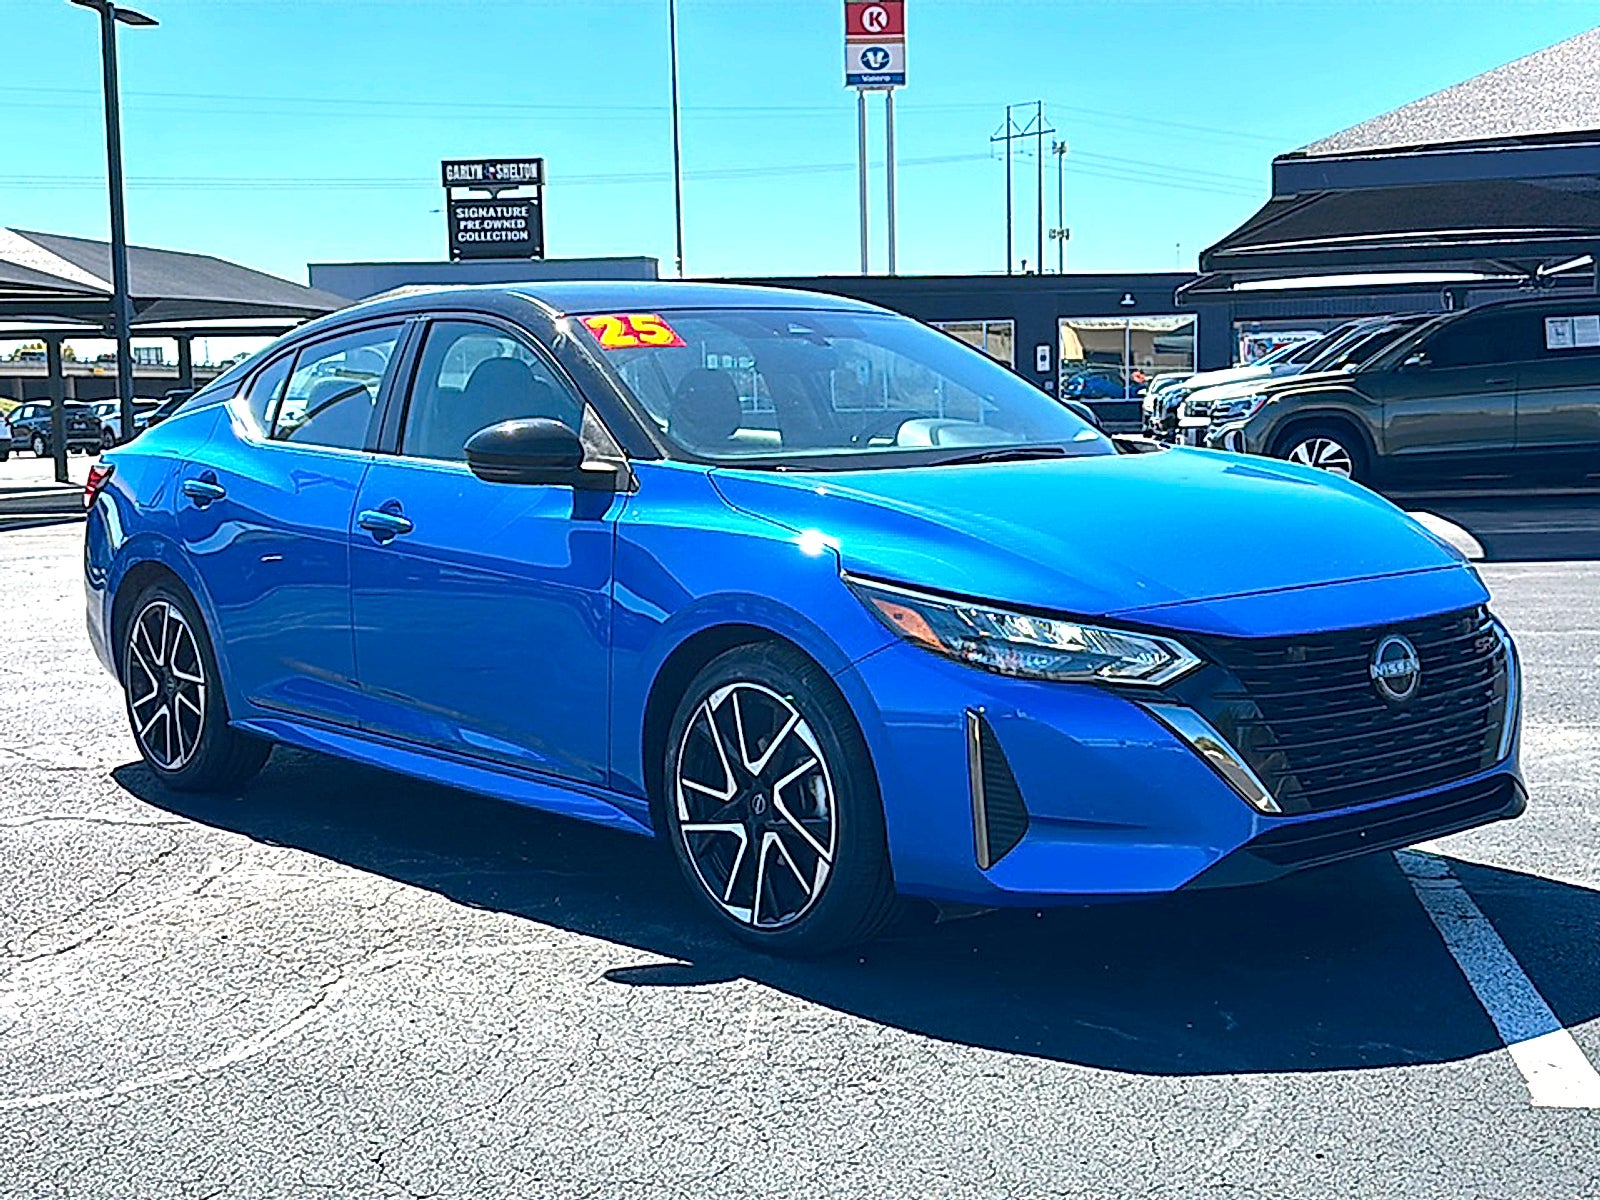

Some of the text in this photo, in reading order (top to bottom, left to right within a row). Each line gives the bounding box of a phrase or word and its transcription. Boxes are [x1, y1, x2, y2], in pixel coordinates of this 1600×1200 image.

[446, 163, 537, 180] GARLYN SHELTON
[455, 206, 529, 218] SIGNATURE
[459, 219, 526, 230] PRE-OWNED
[457, 230, 529, 242] COLLECTION
[585, 314, 674, 346] 25
[1369, 655, 1420, 680] NISSAN
